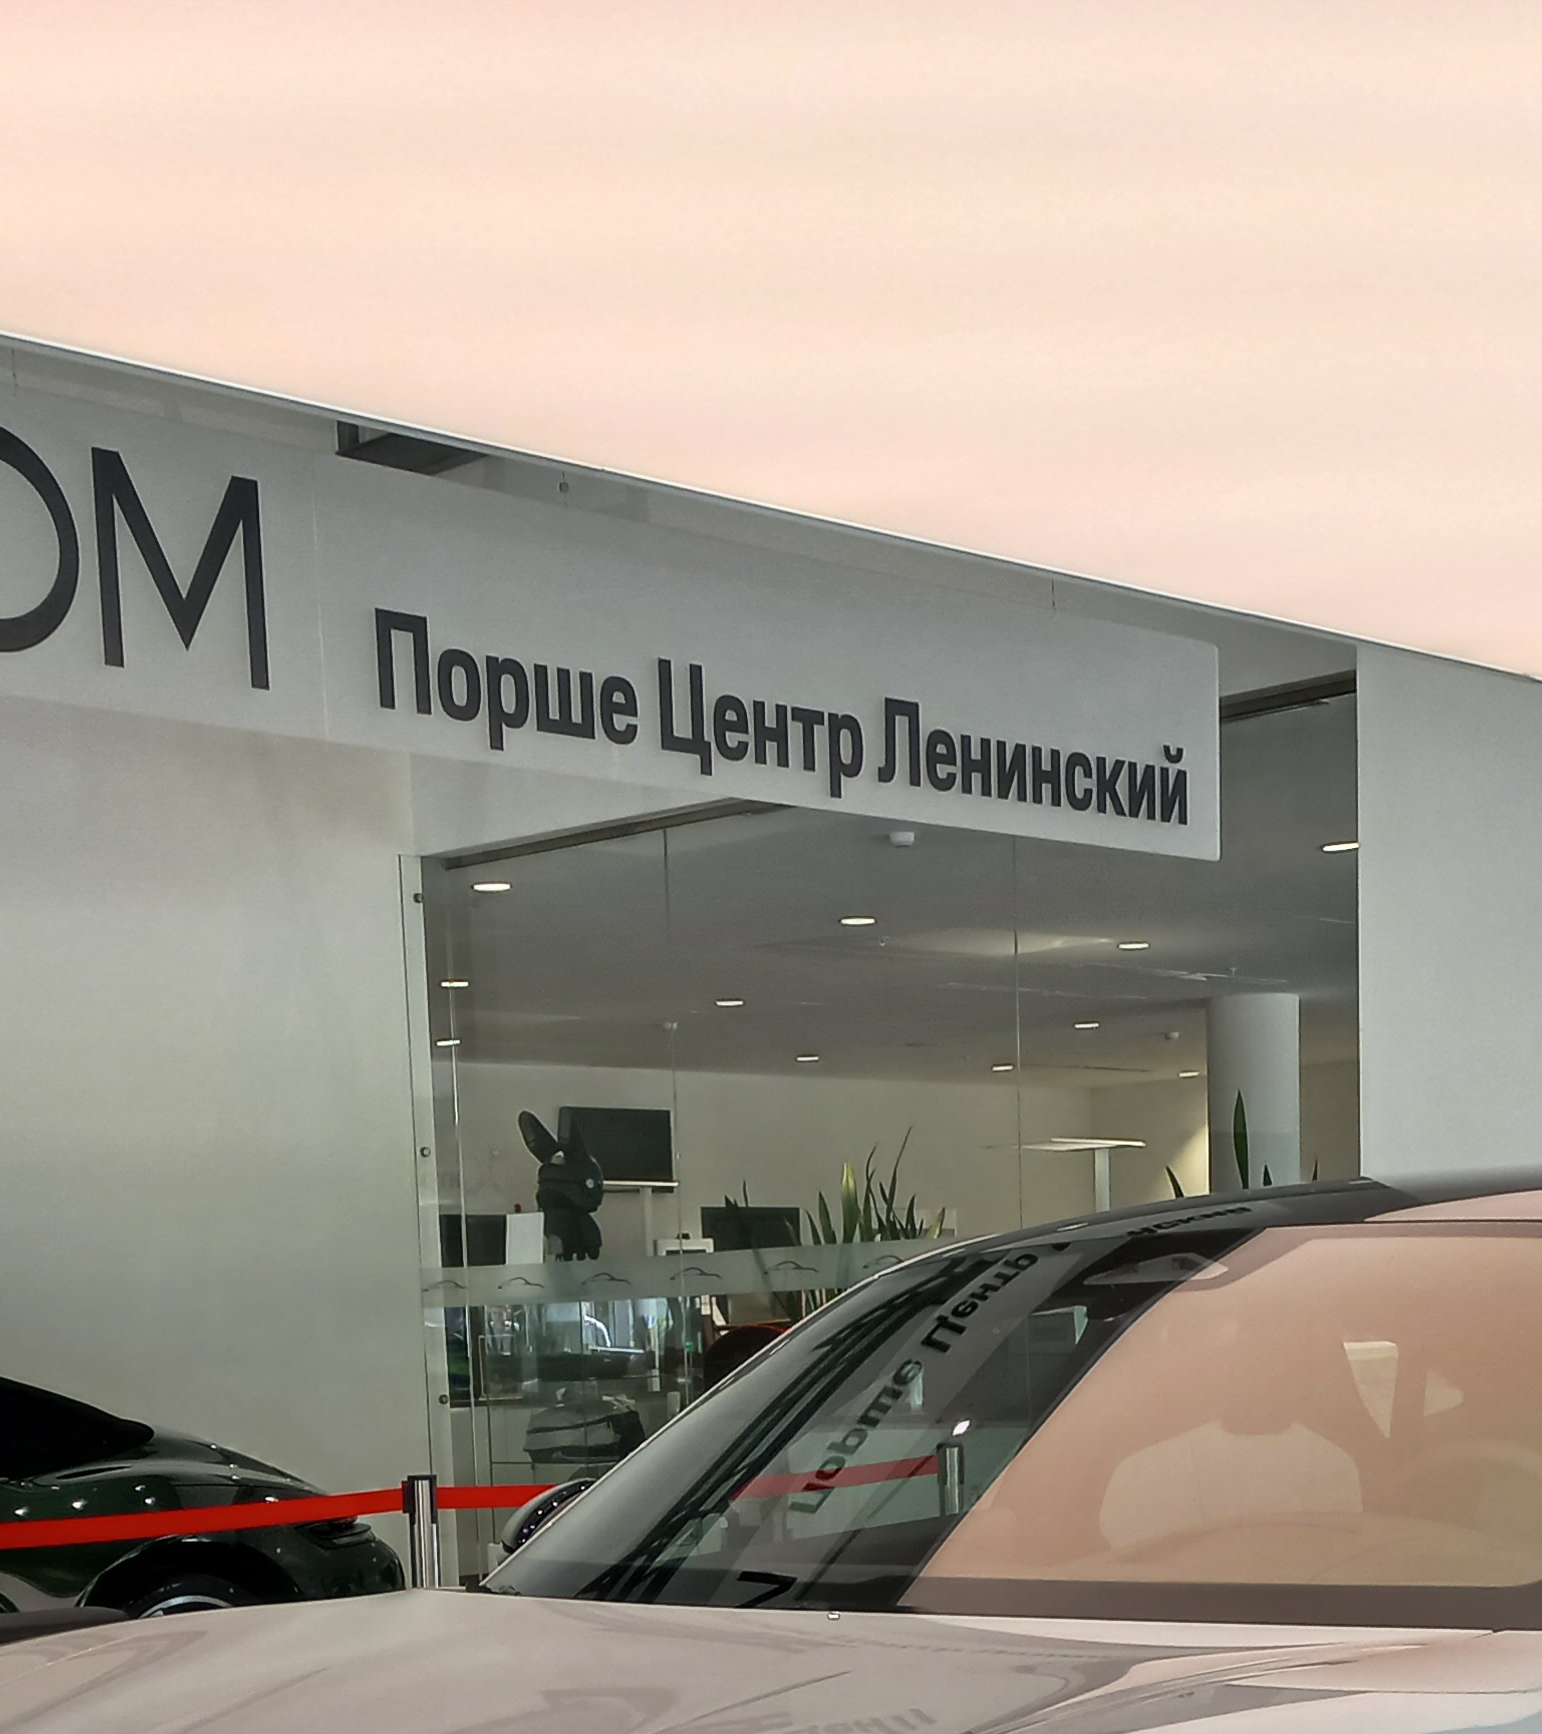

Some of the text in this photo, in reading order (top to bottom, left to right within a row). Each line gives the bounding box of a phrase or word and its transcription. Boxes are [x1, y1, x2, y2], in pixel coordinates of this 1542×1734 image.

[374, 608, 1190, 826] Порше Центр Ленинский
